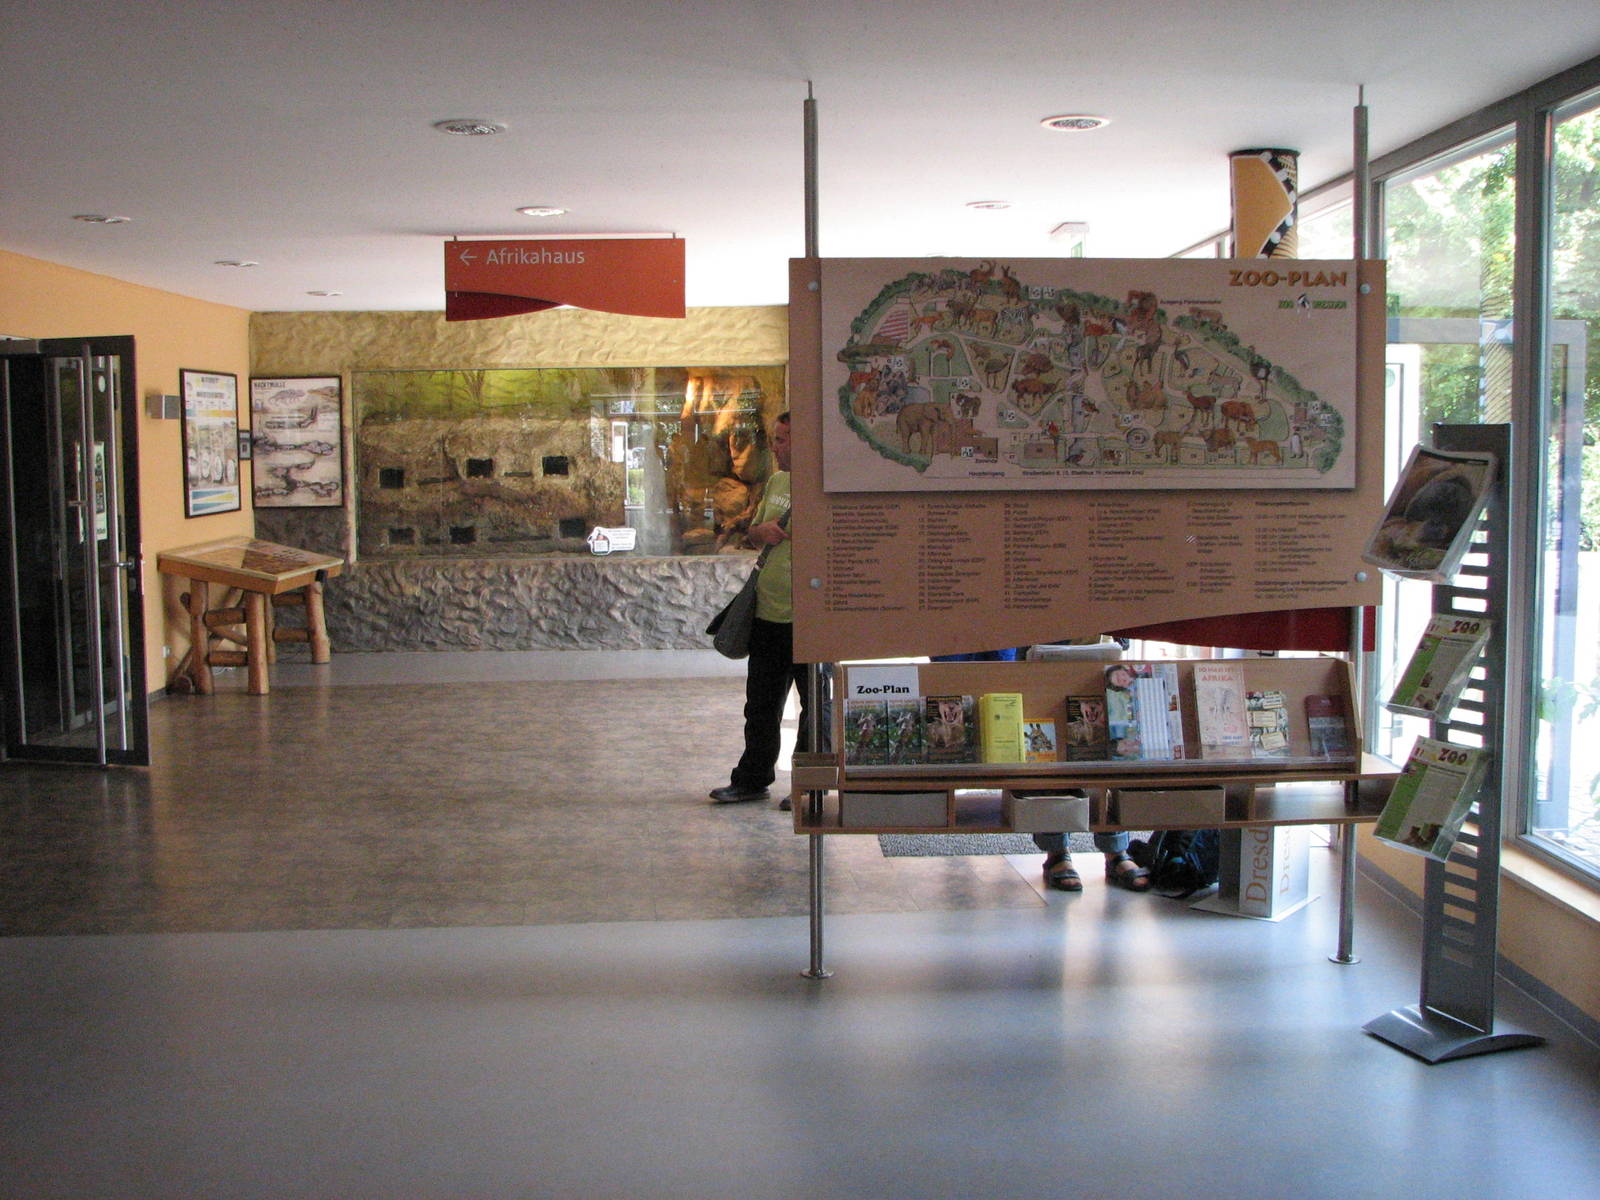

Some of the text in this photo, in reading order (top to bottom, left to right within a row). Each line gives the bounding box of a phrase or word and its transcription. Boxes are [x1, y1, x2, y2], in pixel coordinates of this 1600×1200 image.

[486, 247, 585, 265] Afrikahaus
[1229, 269, 1348, 287] ZOO-PLAN
[857, 685, 910, 694] Zoo-Plan
[1438, 748, 1468, 765] ZOO
